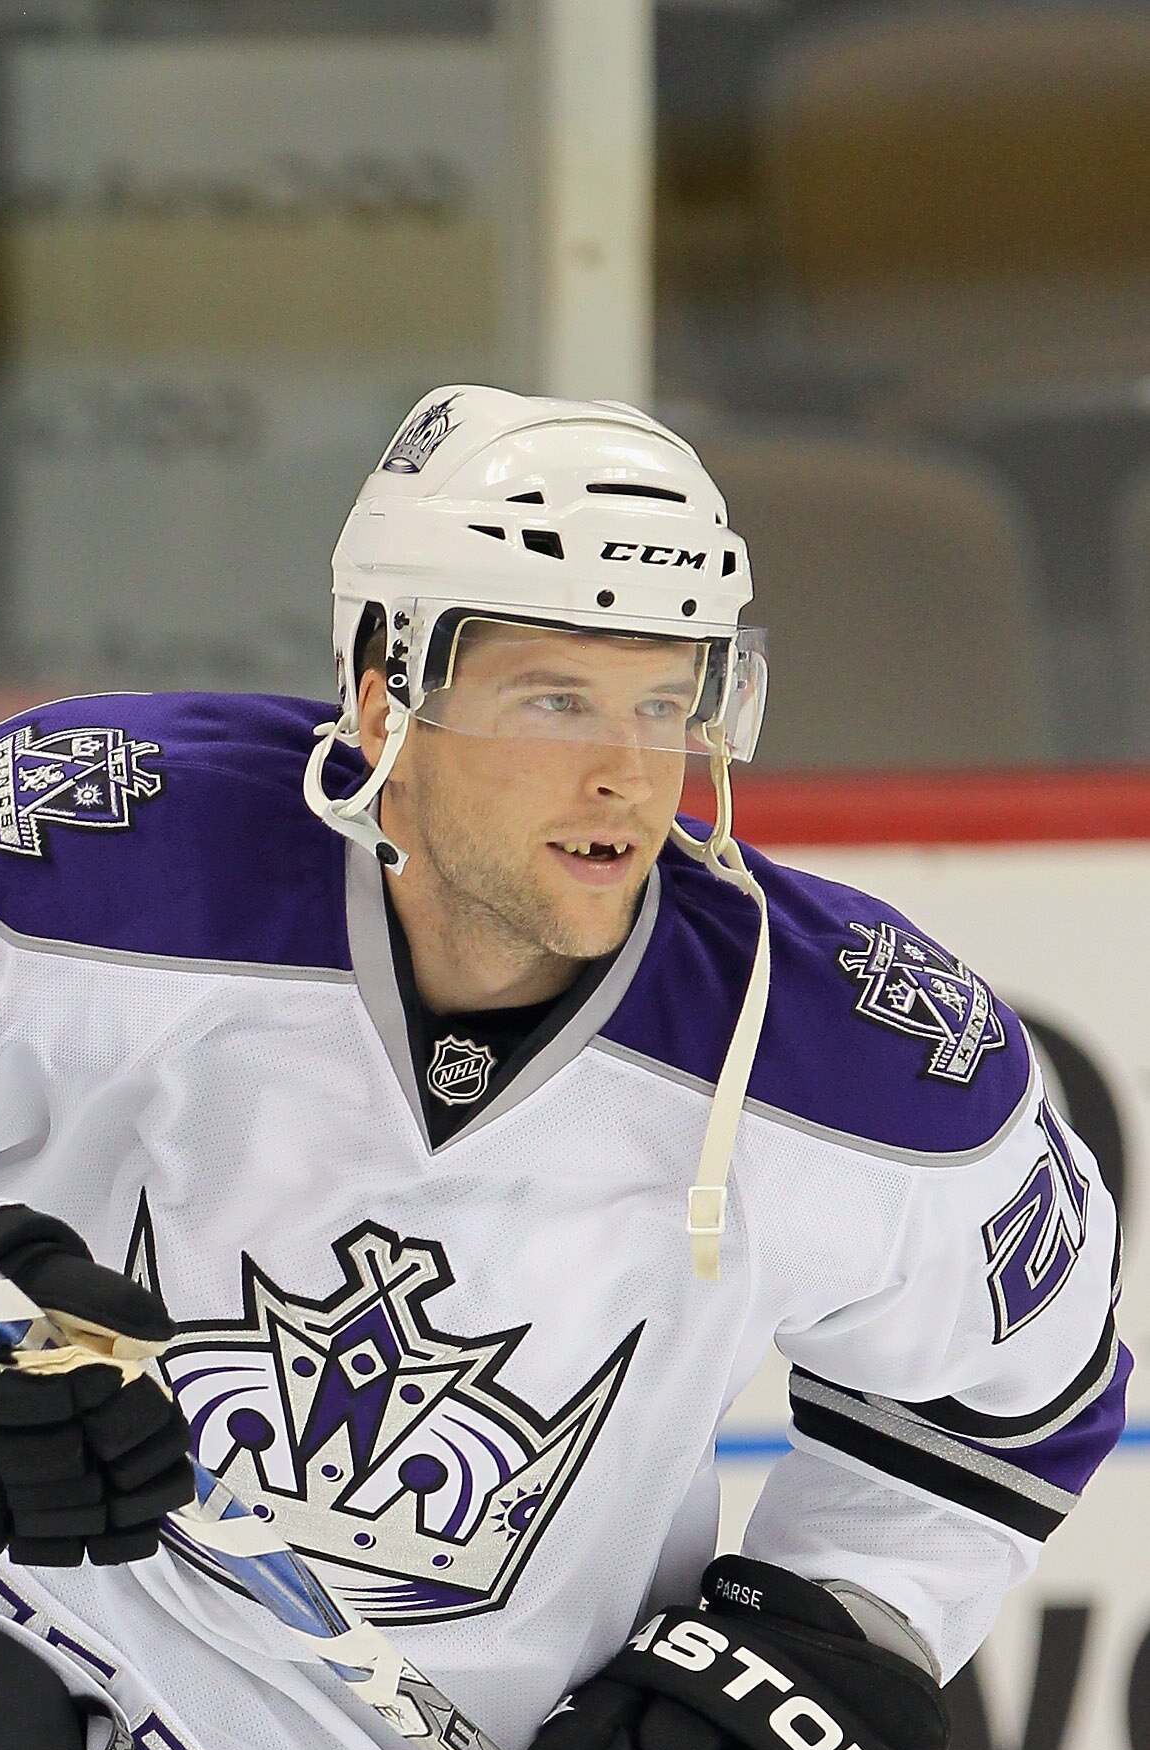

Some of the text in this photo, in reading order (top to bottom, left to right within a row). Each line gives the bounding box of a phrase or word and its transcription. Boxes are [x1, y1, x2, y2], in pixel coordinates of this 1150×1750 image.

[599, 541, 707, 570] CCM
[438, 1060, 480, 1085] NHL
[981, 1098, 1090, 1345] 21
[715, 1577, 763, 1611] PARSE
